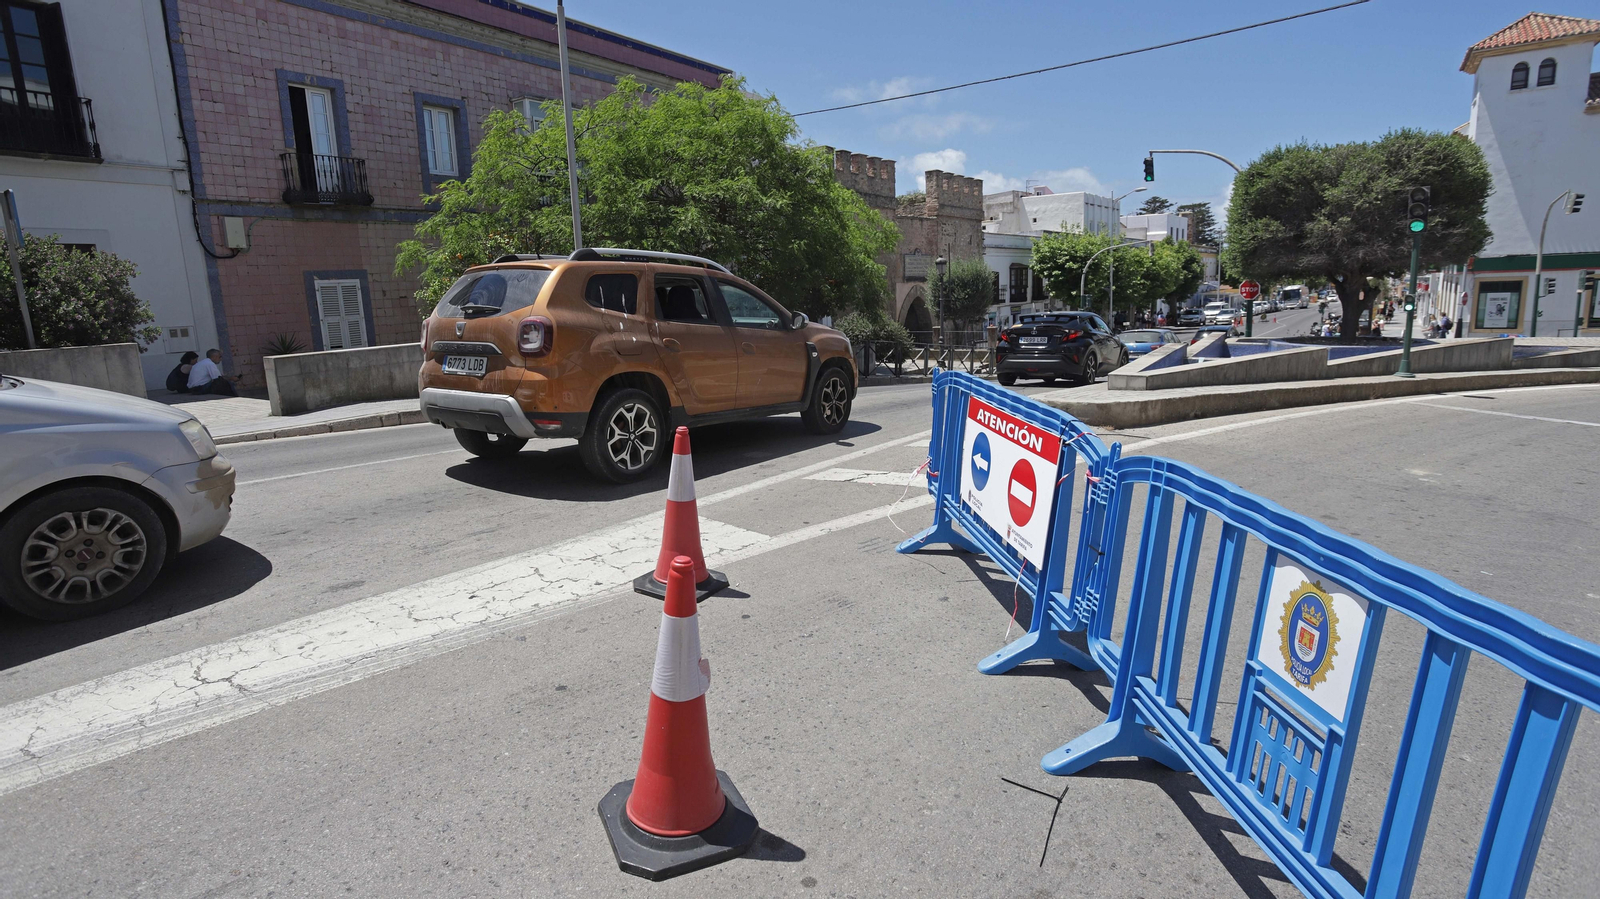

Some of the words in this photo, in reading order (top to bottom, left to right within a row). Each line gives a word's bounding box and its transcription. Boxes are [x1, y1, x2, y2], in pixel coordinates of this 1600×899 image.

[439, 343, 483, 352] DUSTER
[447, 357, 467, 371] 6773
[467, 358, 485, 372] LDB
[976, 408, 1043, 453] ATENCIÓN
[1011, 529, 1033, 549] AYUNTAMIENTO
[1292, 668, 1309, 684] TARIFA
